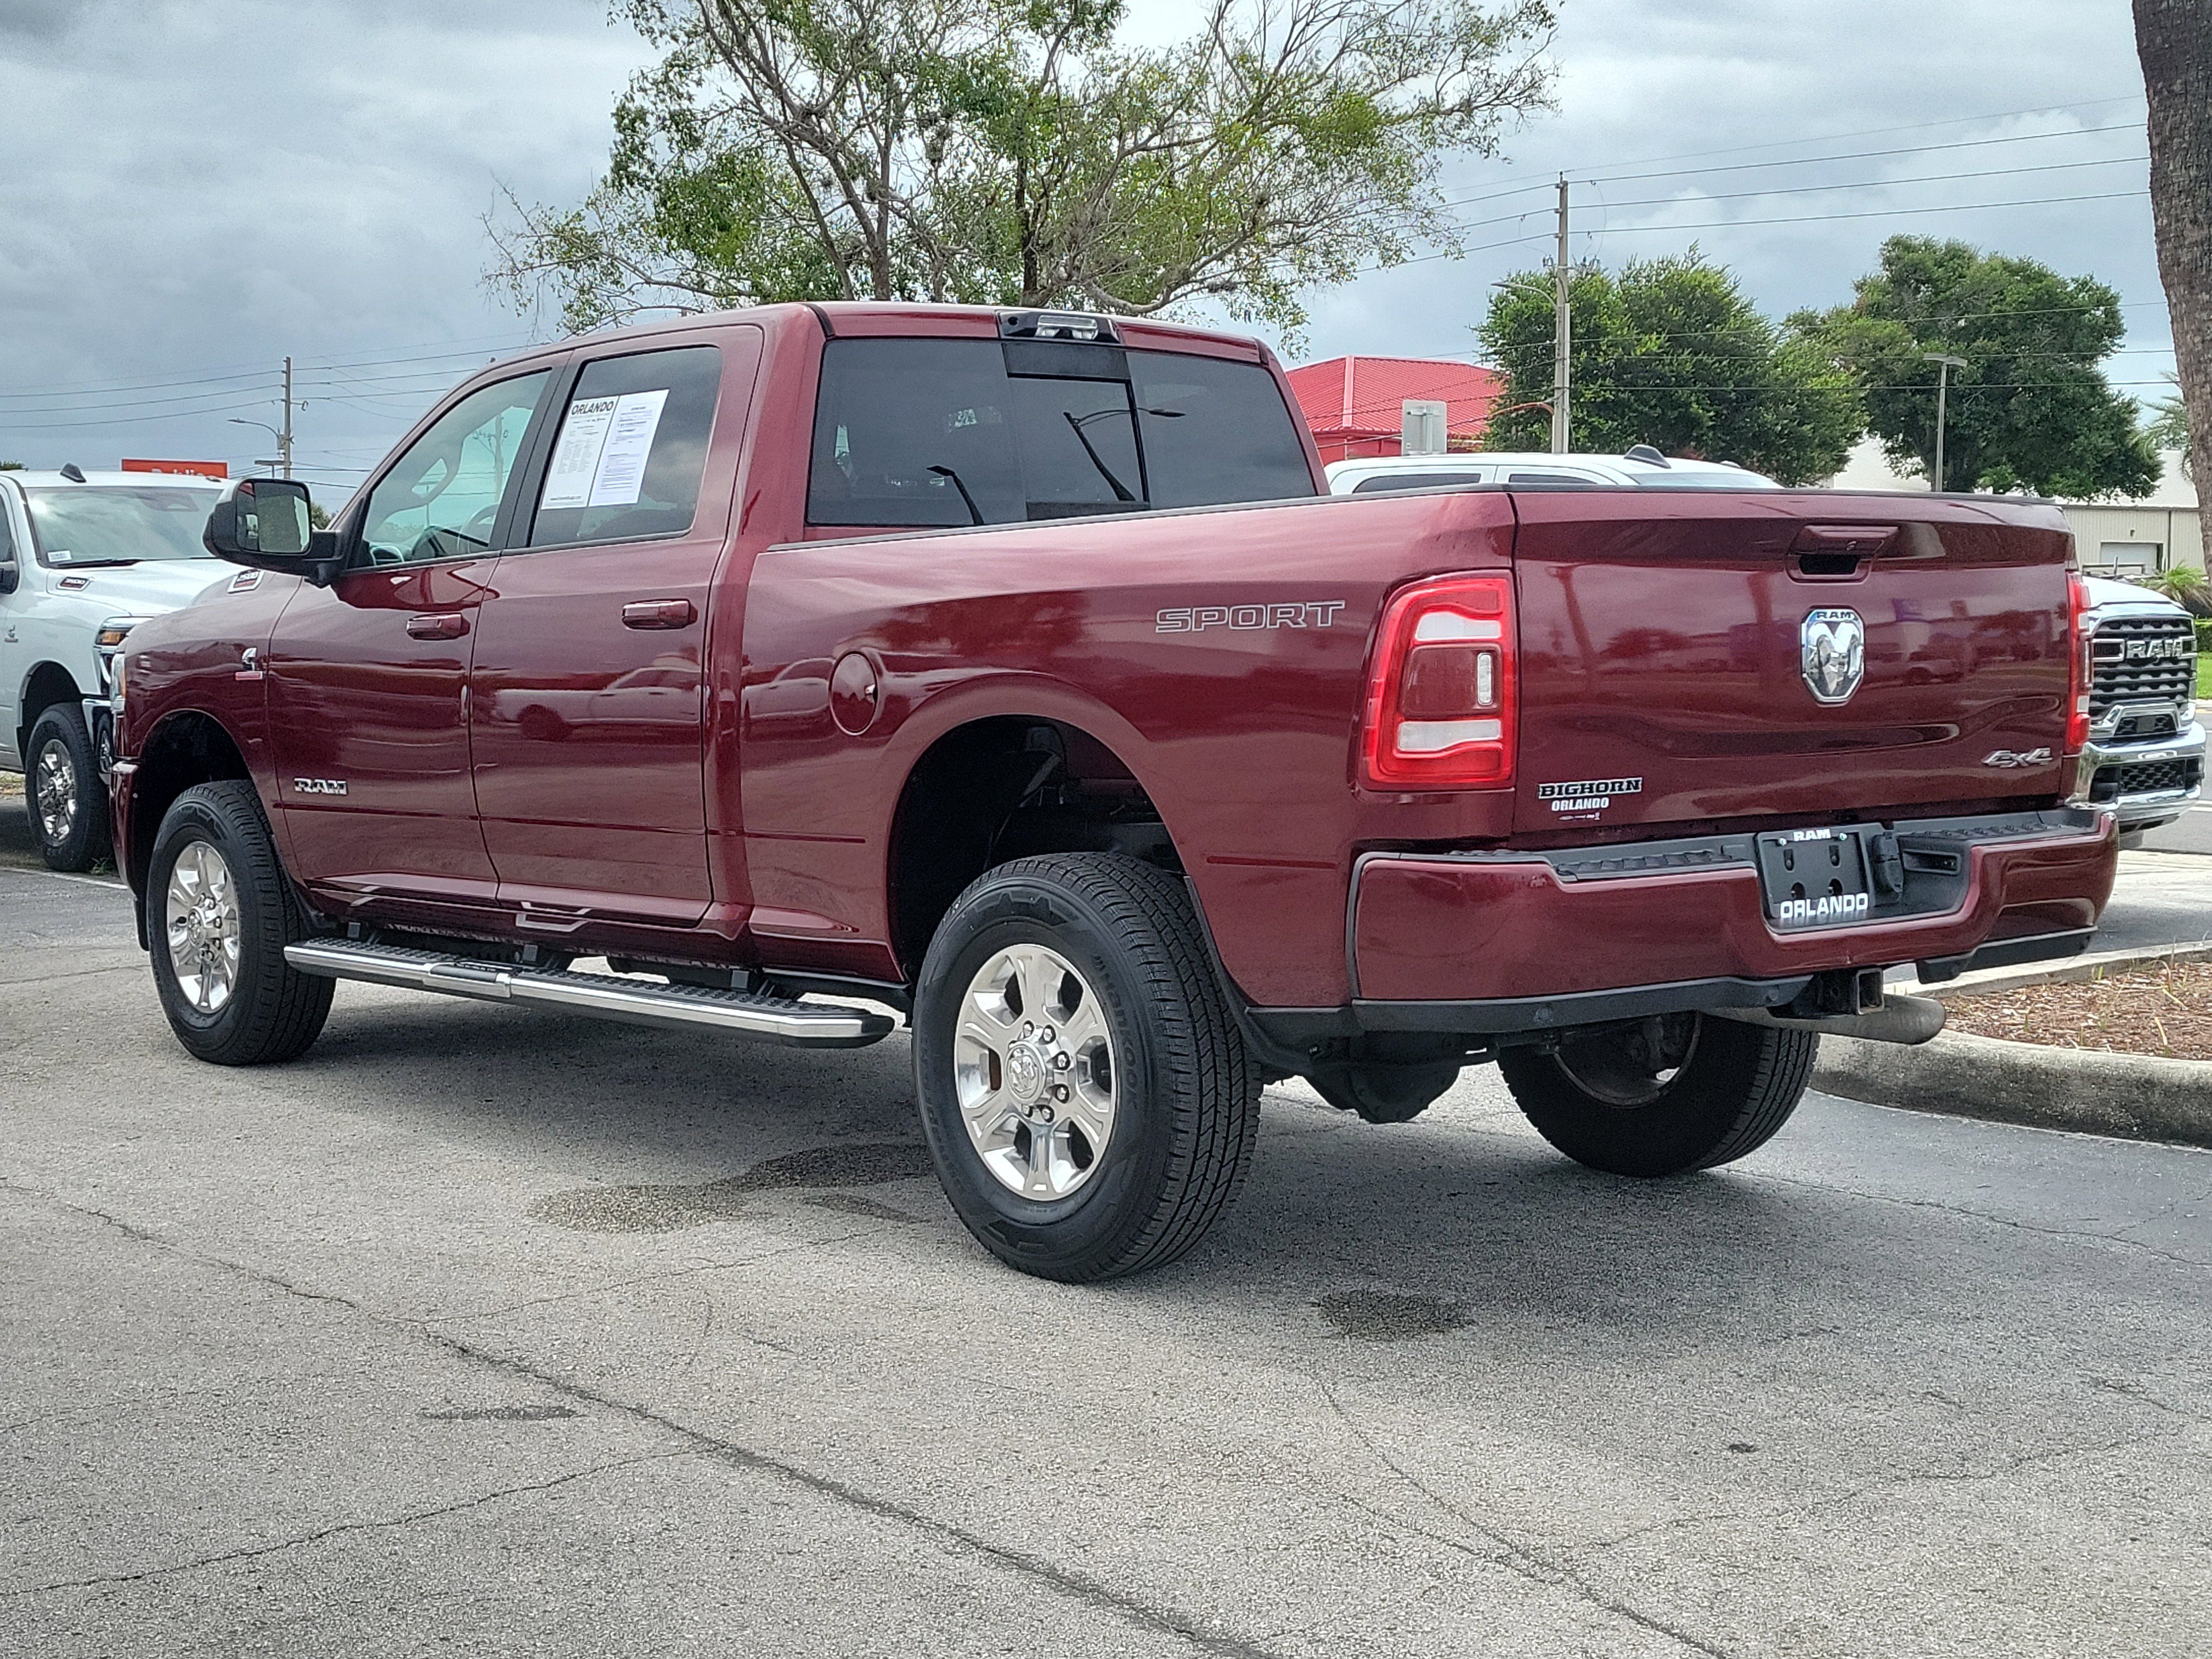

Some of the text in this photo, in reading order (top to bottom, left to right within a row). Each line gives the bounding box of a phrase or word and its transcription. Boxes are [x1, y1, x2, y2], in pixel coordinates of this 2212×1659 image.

[571, 401, 614, 415] ORLANDO
[1155, 600, 1345, 633] SPORT
[2126, 639, 2183, 658] RAM
[294, 778, 347, 795] RAM
[1538, 777, 1643, 799] BIGHORN
[1551, 797, 1610, 811] ORLANDO
[1793, 829, 1831, 842] RAM
[1780, 893, 1869, 918] ORLANDO
